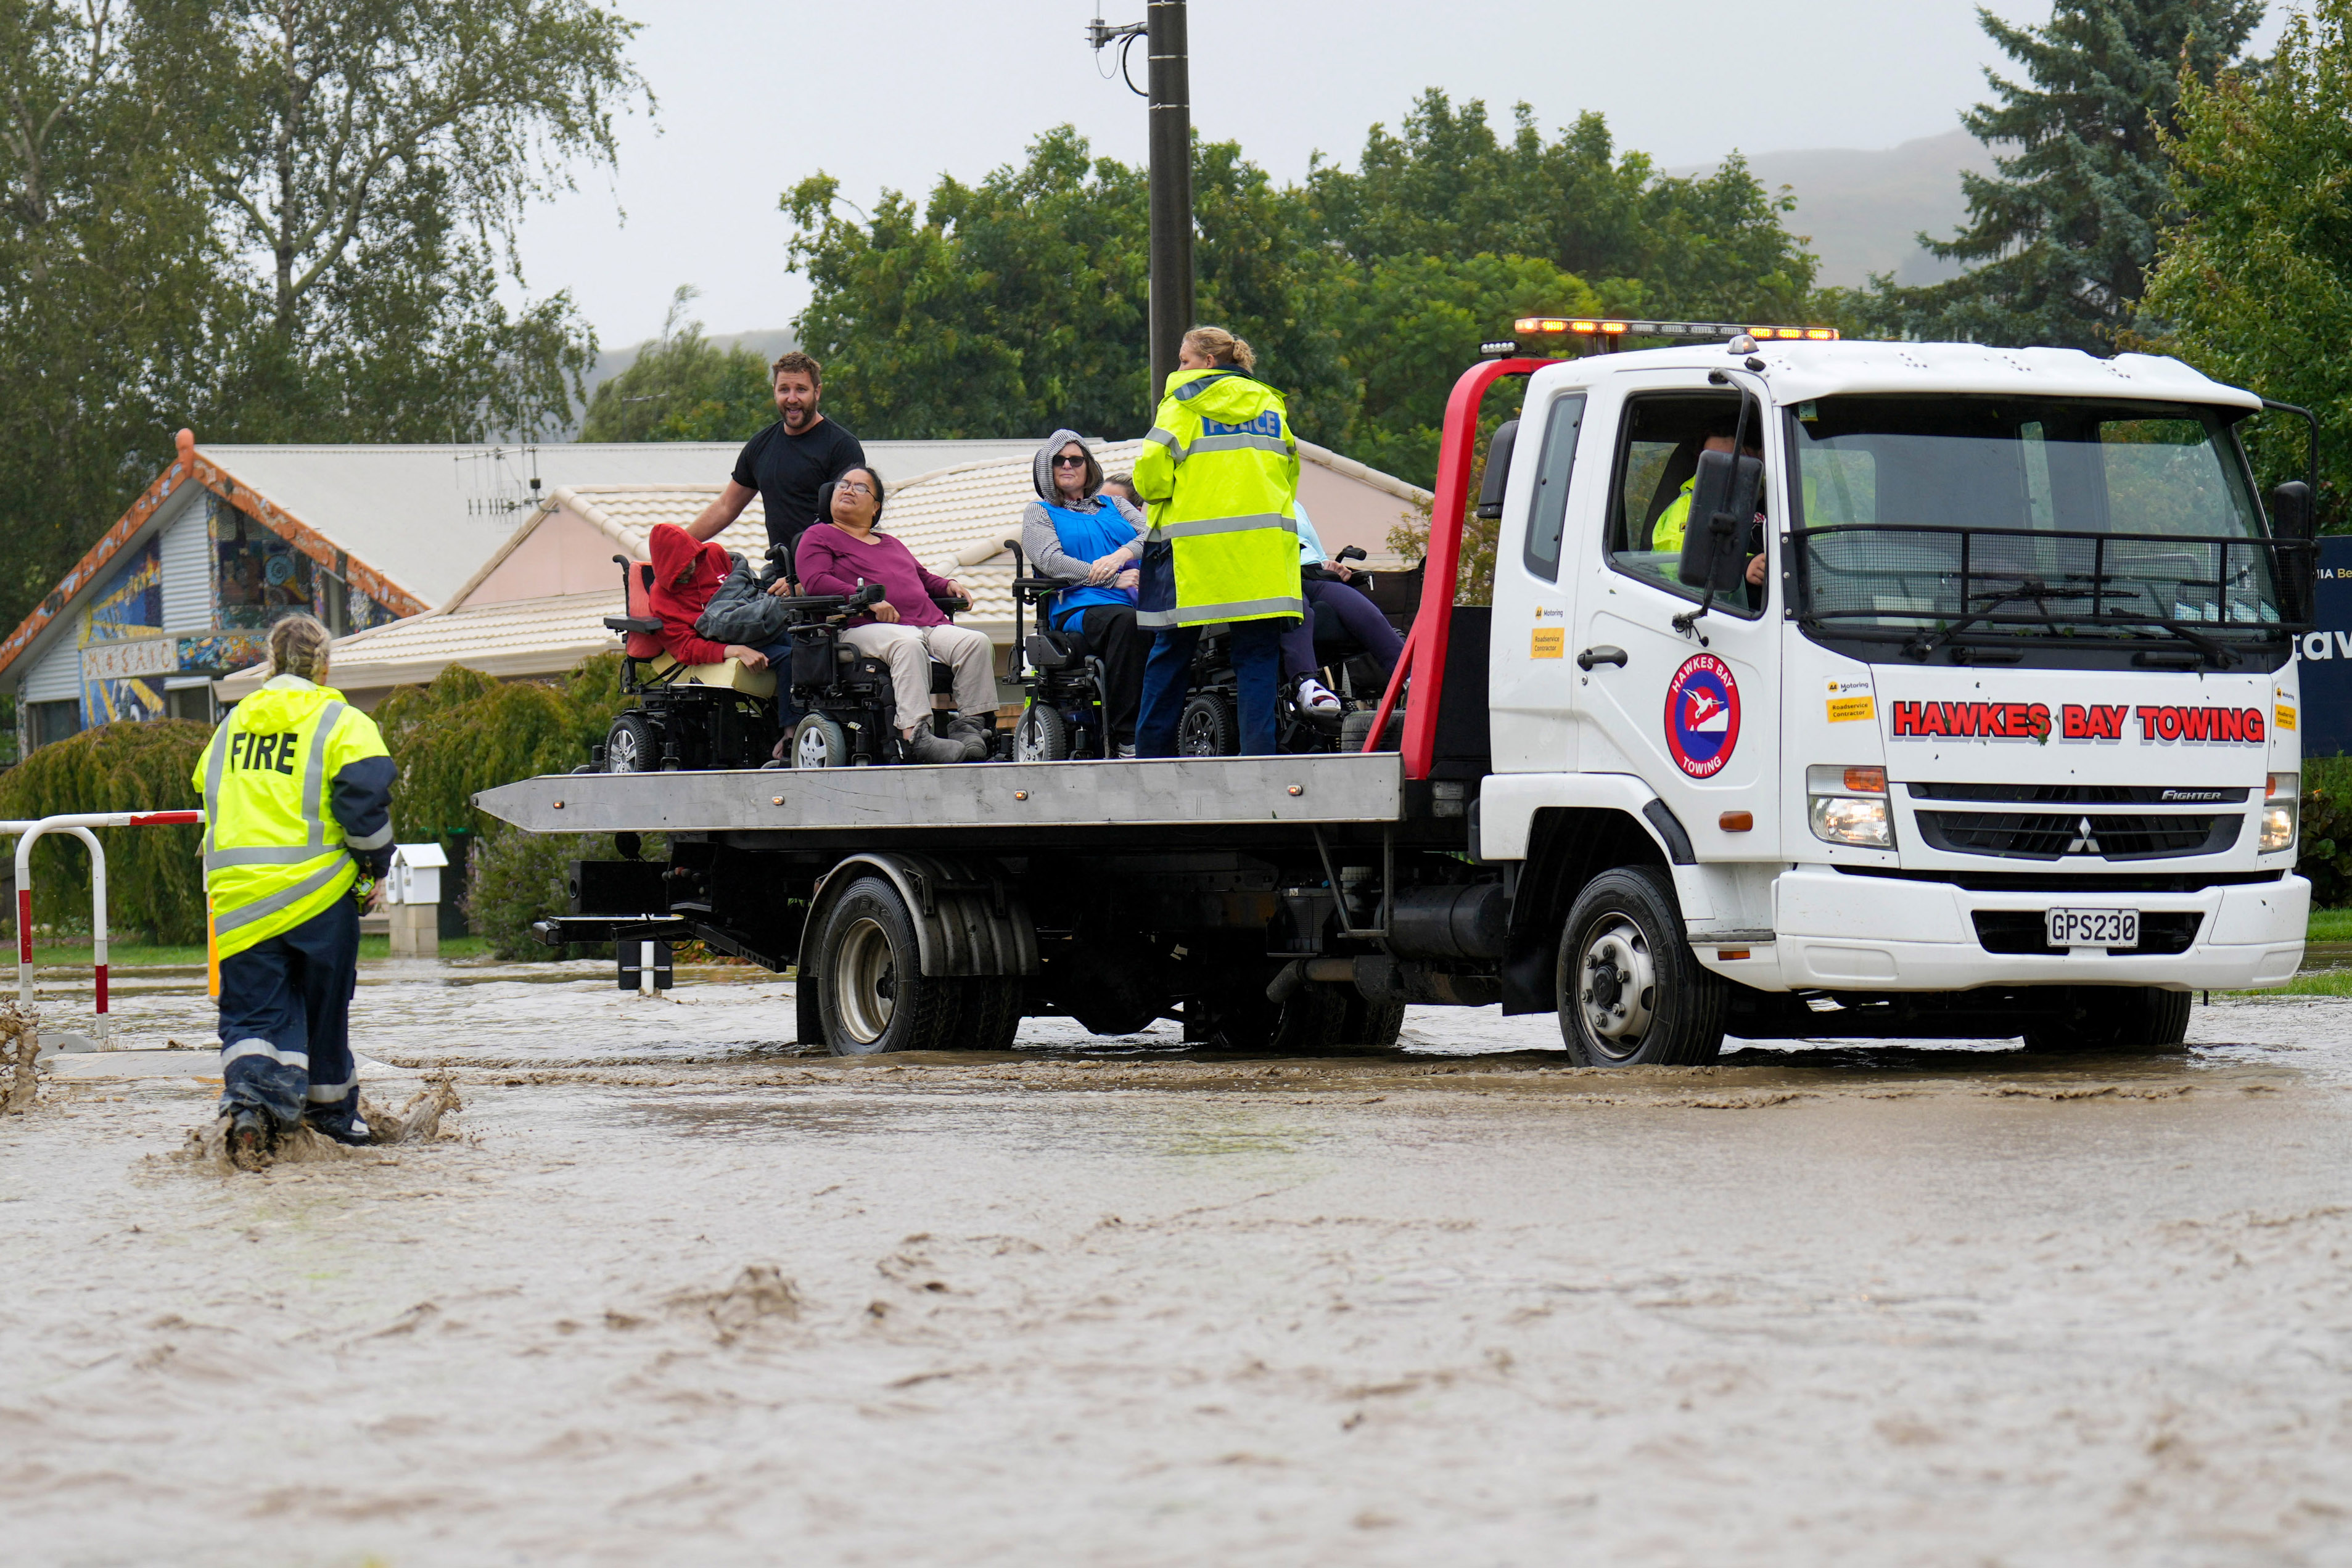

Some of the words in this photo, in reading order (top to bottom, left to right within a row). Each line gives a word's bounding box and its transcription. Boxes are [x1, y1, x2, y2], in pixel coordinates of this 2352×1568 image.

[1544, 609, 1563, 618] Motoring
[87, 642, 170, 676] MOSAIC
[1672, 656, 1714, 693] HAWKES
[1716, 663, 1734, 688] BAY
[1893, 701, 2052, 739] HAWKES
[2062, 704, 2130, 740] BAY
[2136, 705, 2265, 743] TOWING
[231, 732, 298, 775] FIRE
[1683, 755, 1722, 774] TOWING
[2161, 790, 2221, 800] FIGHTER
[2053, 914, 2136, 941] GPS230
